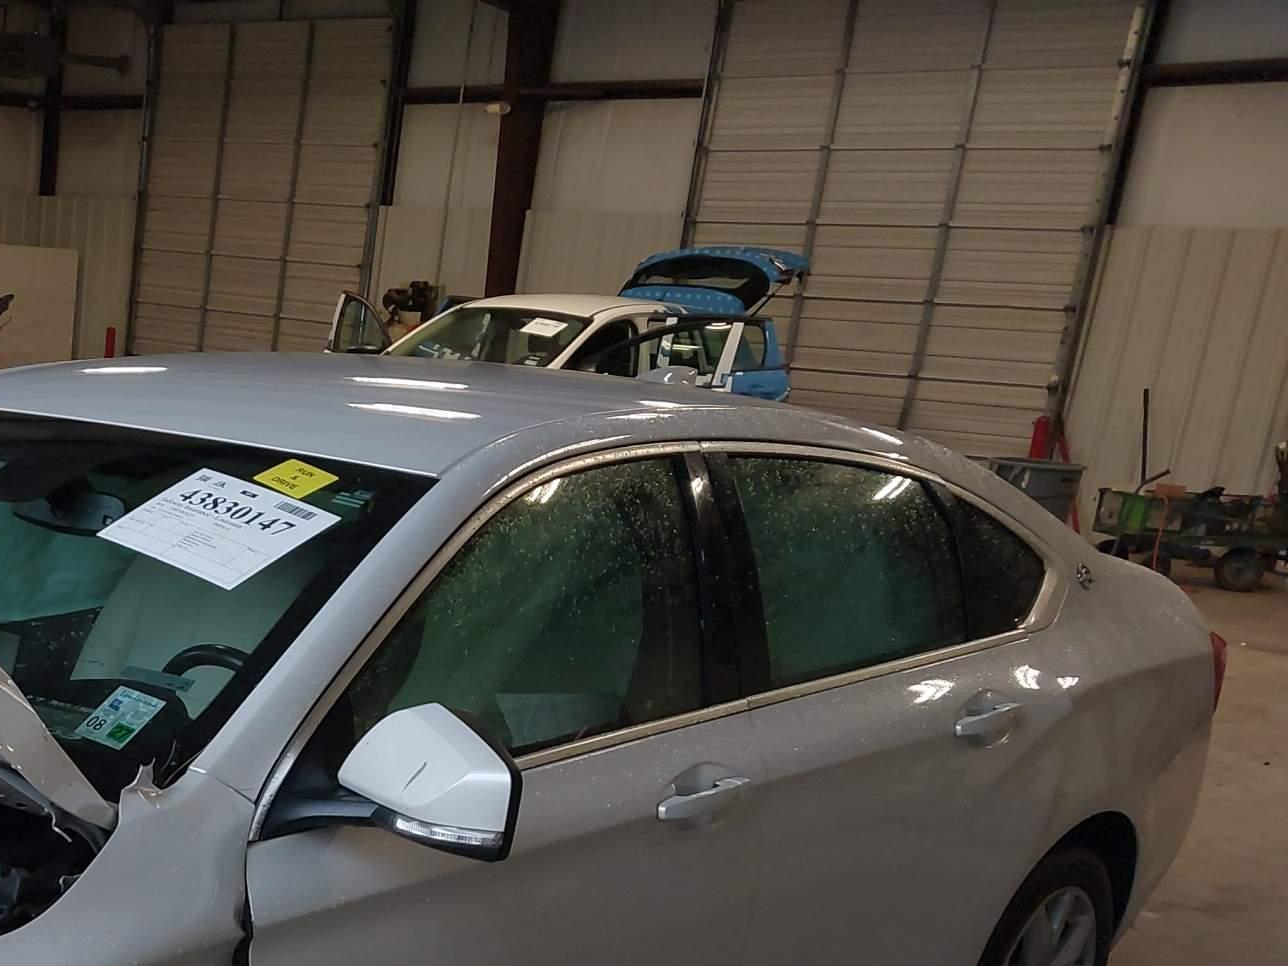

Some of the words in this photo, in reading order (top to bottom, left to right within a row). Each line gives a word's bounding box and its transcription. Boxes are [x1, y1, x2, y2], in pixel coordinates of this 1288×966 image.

[296, 467, 317, 478] RUN
[271, 476, 298, 490] DRIVE
[179, 489, 296, 536] 43830147
[86, 716, 107, 731] 08
